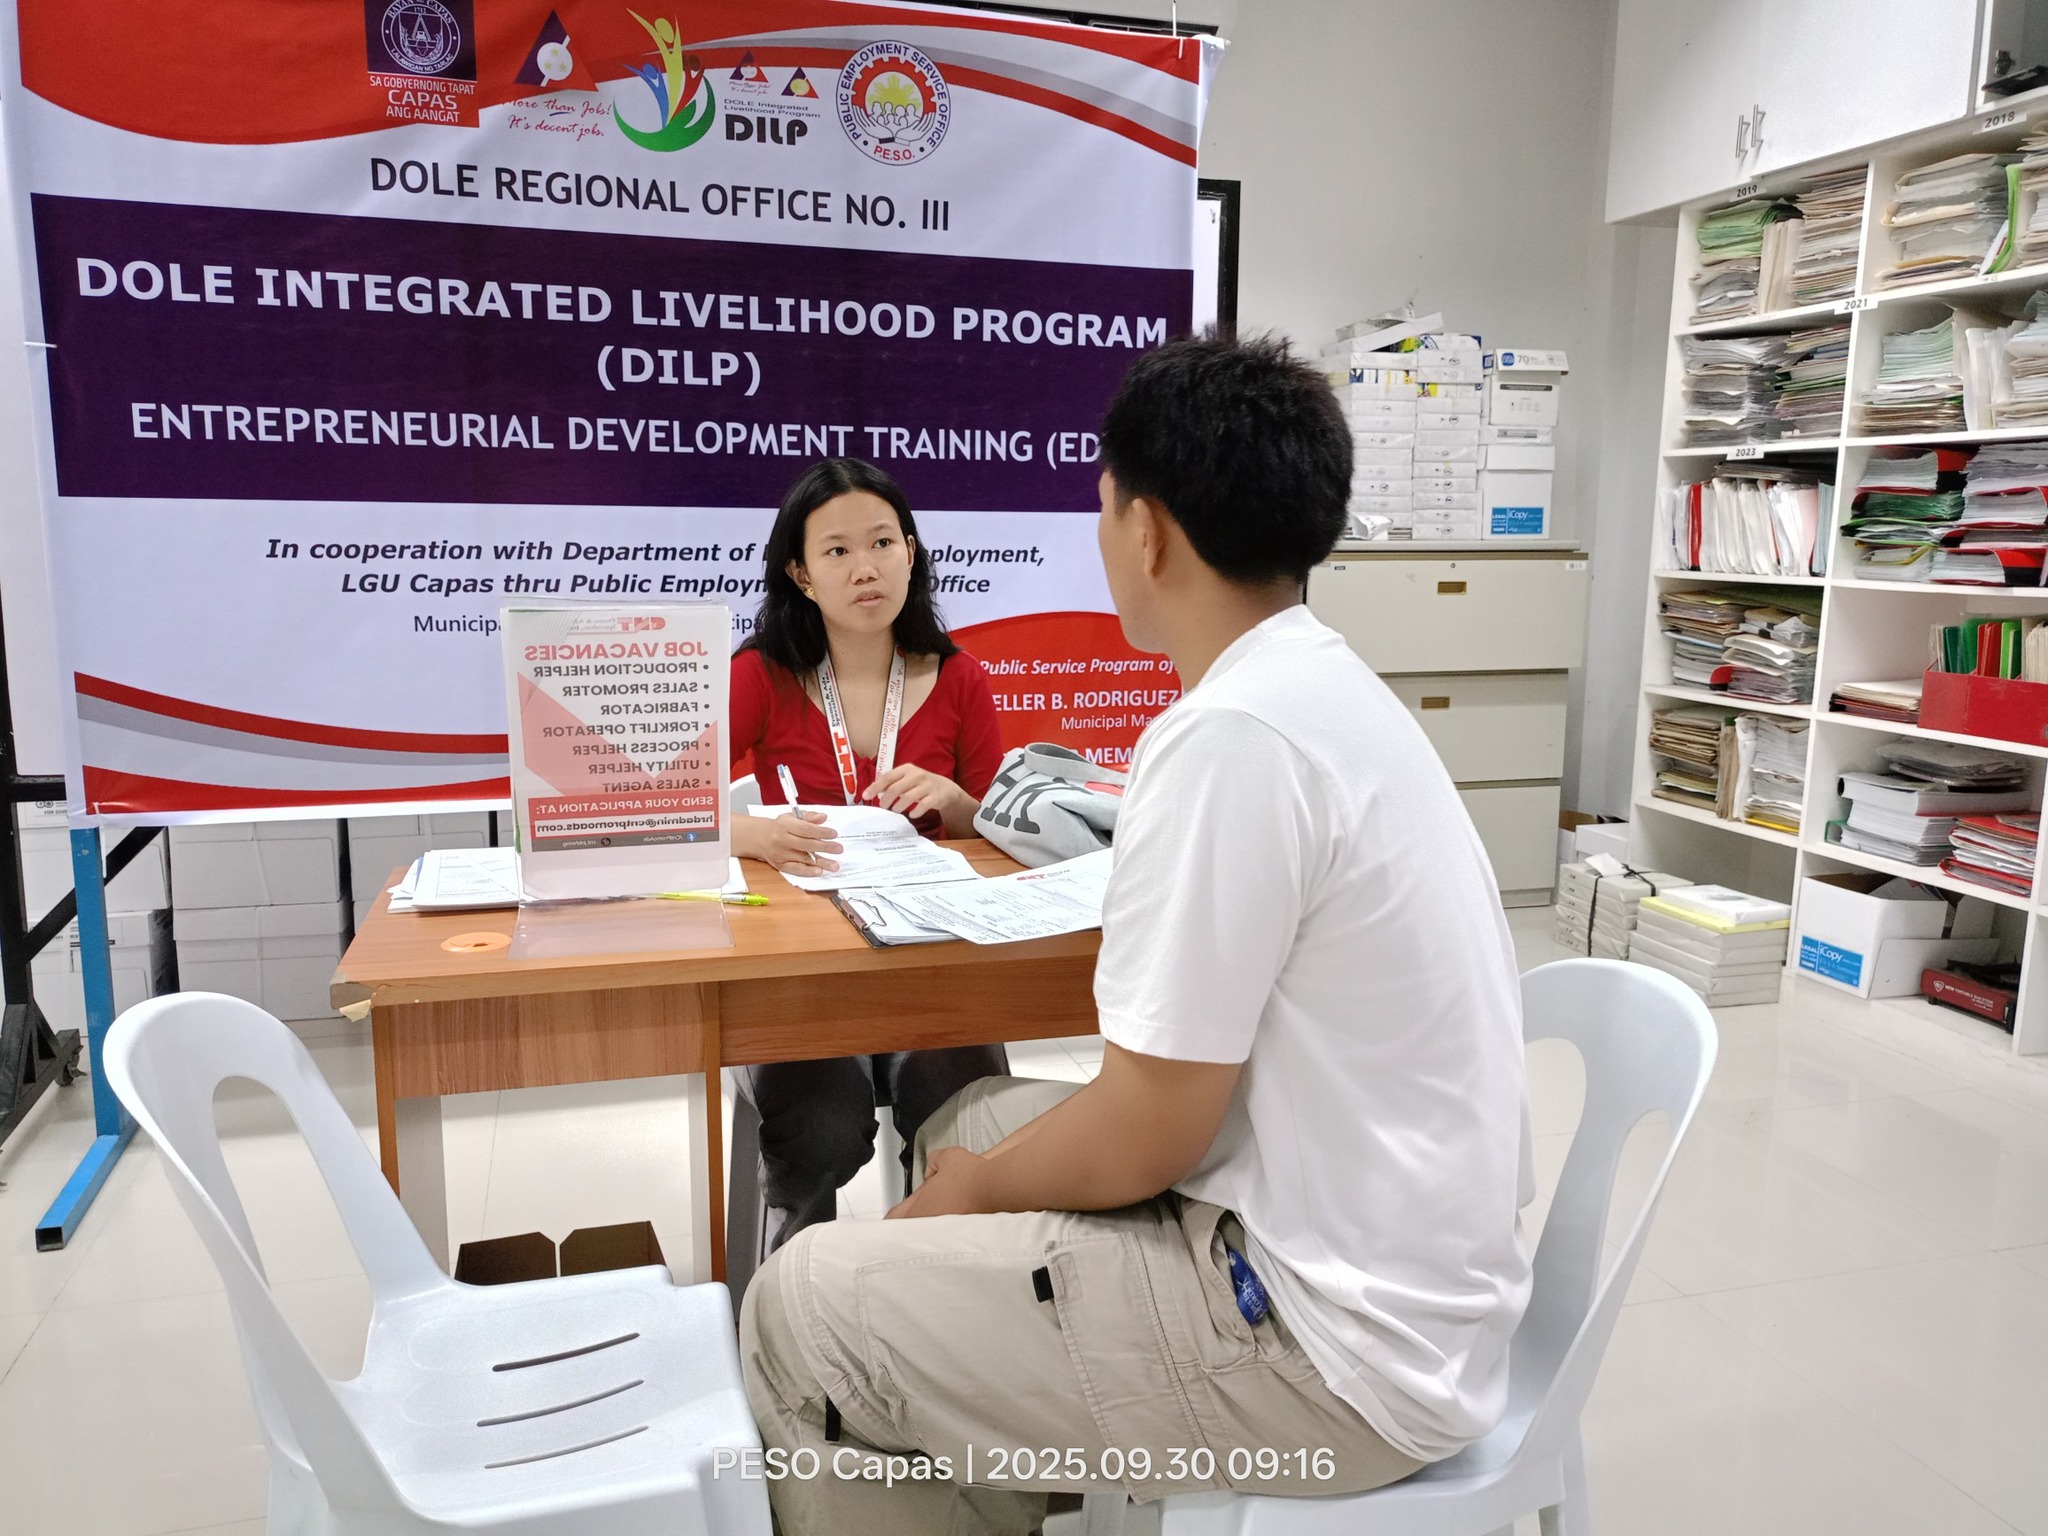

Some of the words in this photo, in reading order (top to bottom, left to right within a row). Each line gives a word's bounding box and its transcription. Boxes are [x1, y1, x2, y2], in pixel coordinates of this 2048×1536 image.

[841, 43, 910, 90] EMPLOYMENT
[911, 51, 947, 100] SERVICE
[369, 76, 382, 87] SA
[383, 77, 446, 93] GOBYERNONG
[447, 82, 475, 95] TAPAT
[388, 89, 458, 110] CAPAS
[543, 99, 577, 112] than
[758, 102, 808, 111] Integrated
[386, 106, 412, 119] ANG
[413, 107, 461, 123] AANGAT
[724, 105, 775, 114] Livelihood
[778, 110, 821, 118] Program
[840, 93, 861, 140] PUBLIC
[1985, 111, 2015, 129] 2018
[508, 114, 531, 130] It's
[535, 119, 578, 133] decent
[725, 113, 808, 145] DILP
[926, 103, 948, 148] OFFICE
[873, 145, 915, 161] P.E.S.O.
[371, 157, 479, 198] DOLE
[495, 166, 690, 213] REGIONAL
[702, 183, 831, 223] OFFICE
[846, 193, 906, 229] NO.
[922, 199, 949, 231] III
[1736, 184, 1758, 198] 2019
[76, 256, 235, 305] DOLE
[254, 267, 612, 323] INTEGRATED
[631, 289, 936, 341] LIVELIHOOD
[953, 306, 1168, 350] PROGRAM
[1844, 298, 1868, 311] 2021
[597, 344, 763, 397] (DILP)
[130, 402, 554, 451] ENTREPRENEURIAL
[568, 416, 854, 459] DEVELOPMENT
[863, 426, 1034, 464] TRAINING
[1735, 448, 1756, 457] 2023
[265, 538, 300, 559] In
[309, 540, 483, 564] cooperation
[494, 540, 554, 561] with
[562, 541, 722, 565] Department
[728, 543, 757, 562] of
[930, 544, 1045, 567] ployment,
[341, 573, 401, 593] LGU
[410, 573, 494, 597] Capas
[503, 573, 561, 593] thru
[570, 574, 652, 593] Public
[660, 574, 769, 597] Employ
[413, 615, 501, 637] Municip
[1031, 659, 1087, 675] Service
[1090, 658, 1155, 676] Program
[992, 693, 1046, 712] ELLER
[1051, 693, 1068, 711] B.
[1073, 689, 1179, 709] RODRIGUEZ
[1061, 713, 1127, 731] Municipal
[833, 732, 857, 794] CNT
